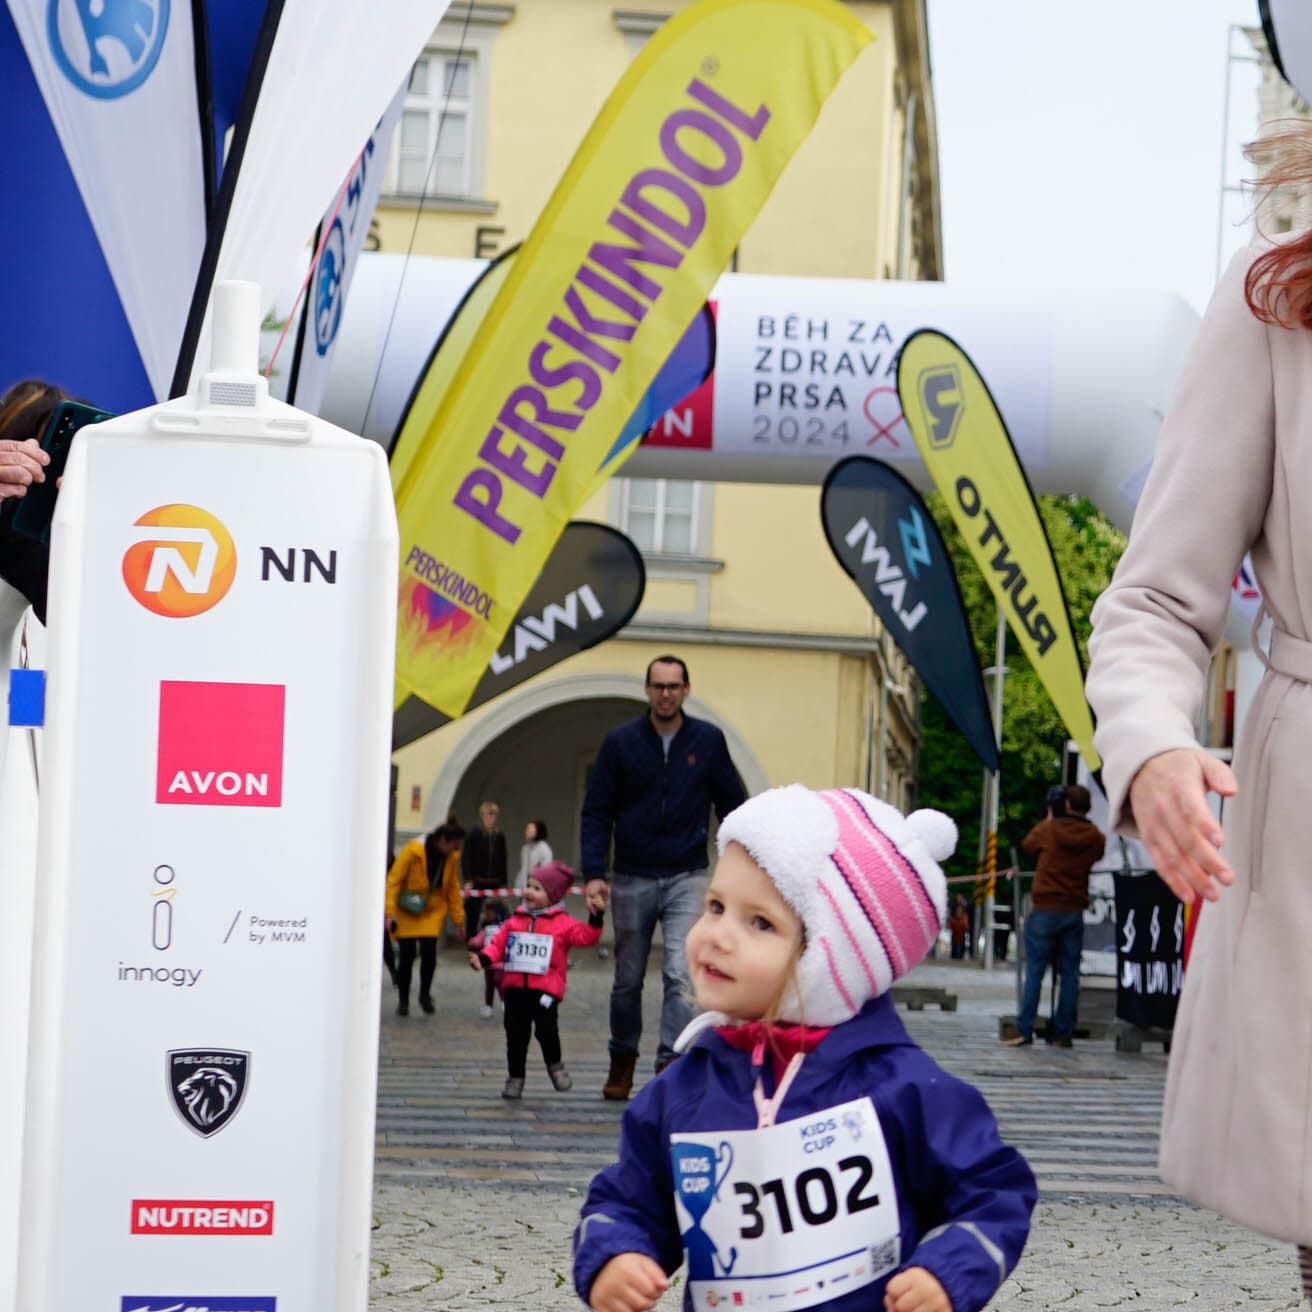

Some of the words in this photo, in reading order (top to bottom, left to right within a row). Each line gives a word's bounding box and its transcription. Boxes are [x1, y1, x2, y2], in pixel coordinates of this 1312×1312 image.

[453, 76, 771, 546] PERSKINDOL
[849, 320, 893, 343] ZA
[754, 383, 848, 411] PRSA
[753, 415, 850, 443] 2024
[260, 546, 338, 584] NN
[404, 544, 495, 622] PERSKINDOL
[490, 583, 604, 676] LAWI
[168, 770, 268, 796] AVON
[250, 916, 307, 928] Powered
[250, 931, 265, 944] by
[271, 932, 305, 942] MVM
[118, 961, 202, 987] innogy
[173, 1056, 244, 1065] PEUGEOT
[800, 1119, 837, 1139] KIDS
[803, 1135, 836, 1154] CUP
[679, 1157, 711, 1173] KIDS
[732, 1154, 879, 1240] 3102
[138, 1207, 269, 1229] NUTREND
